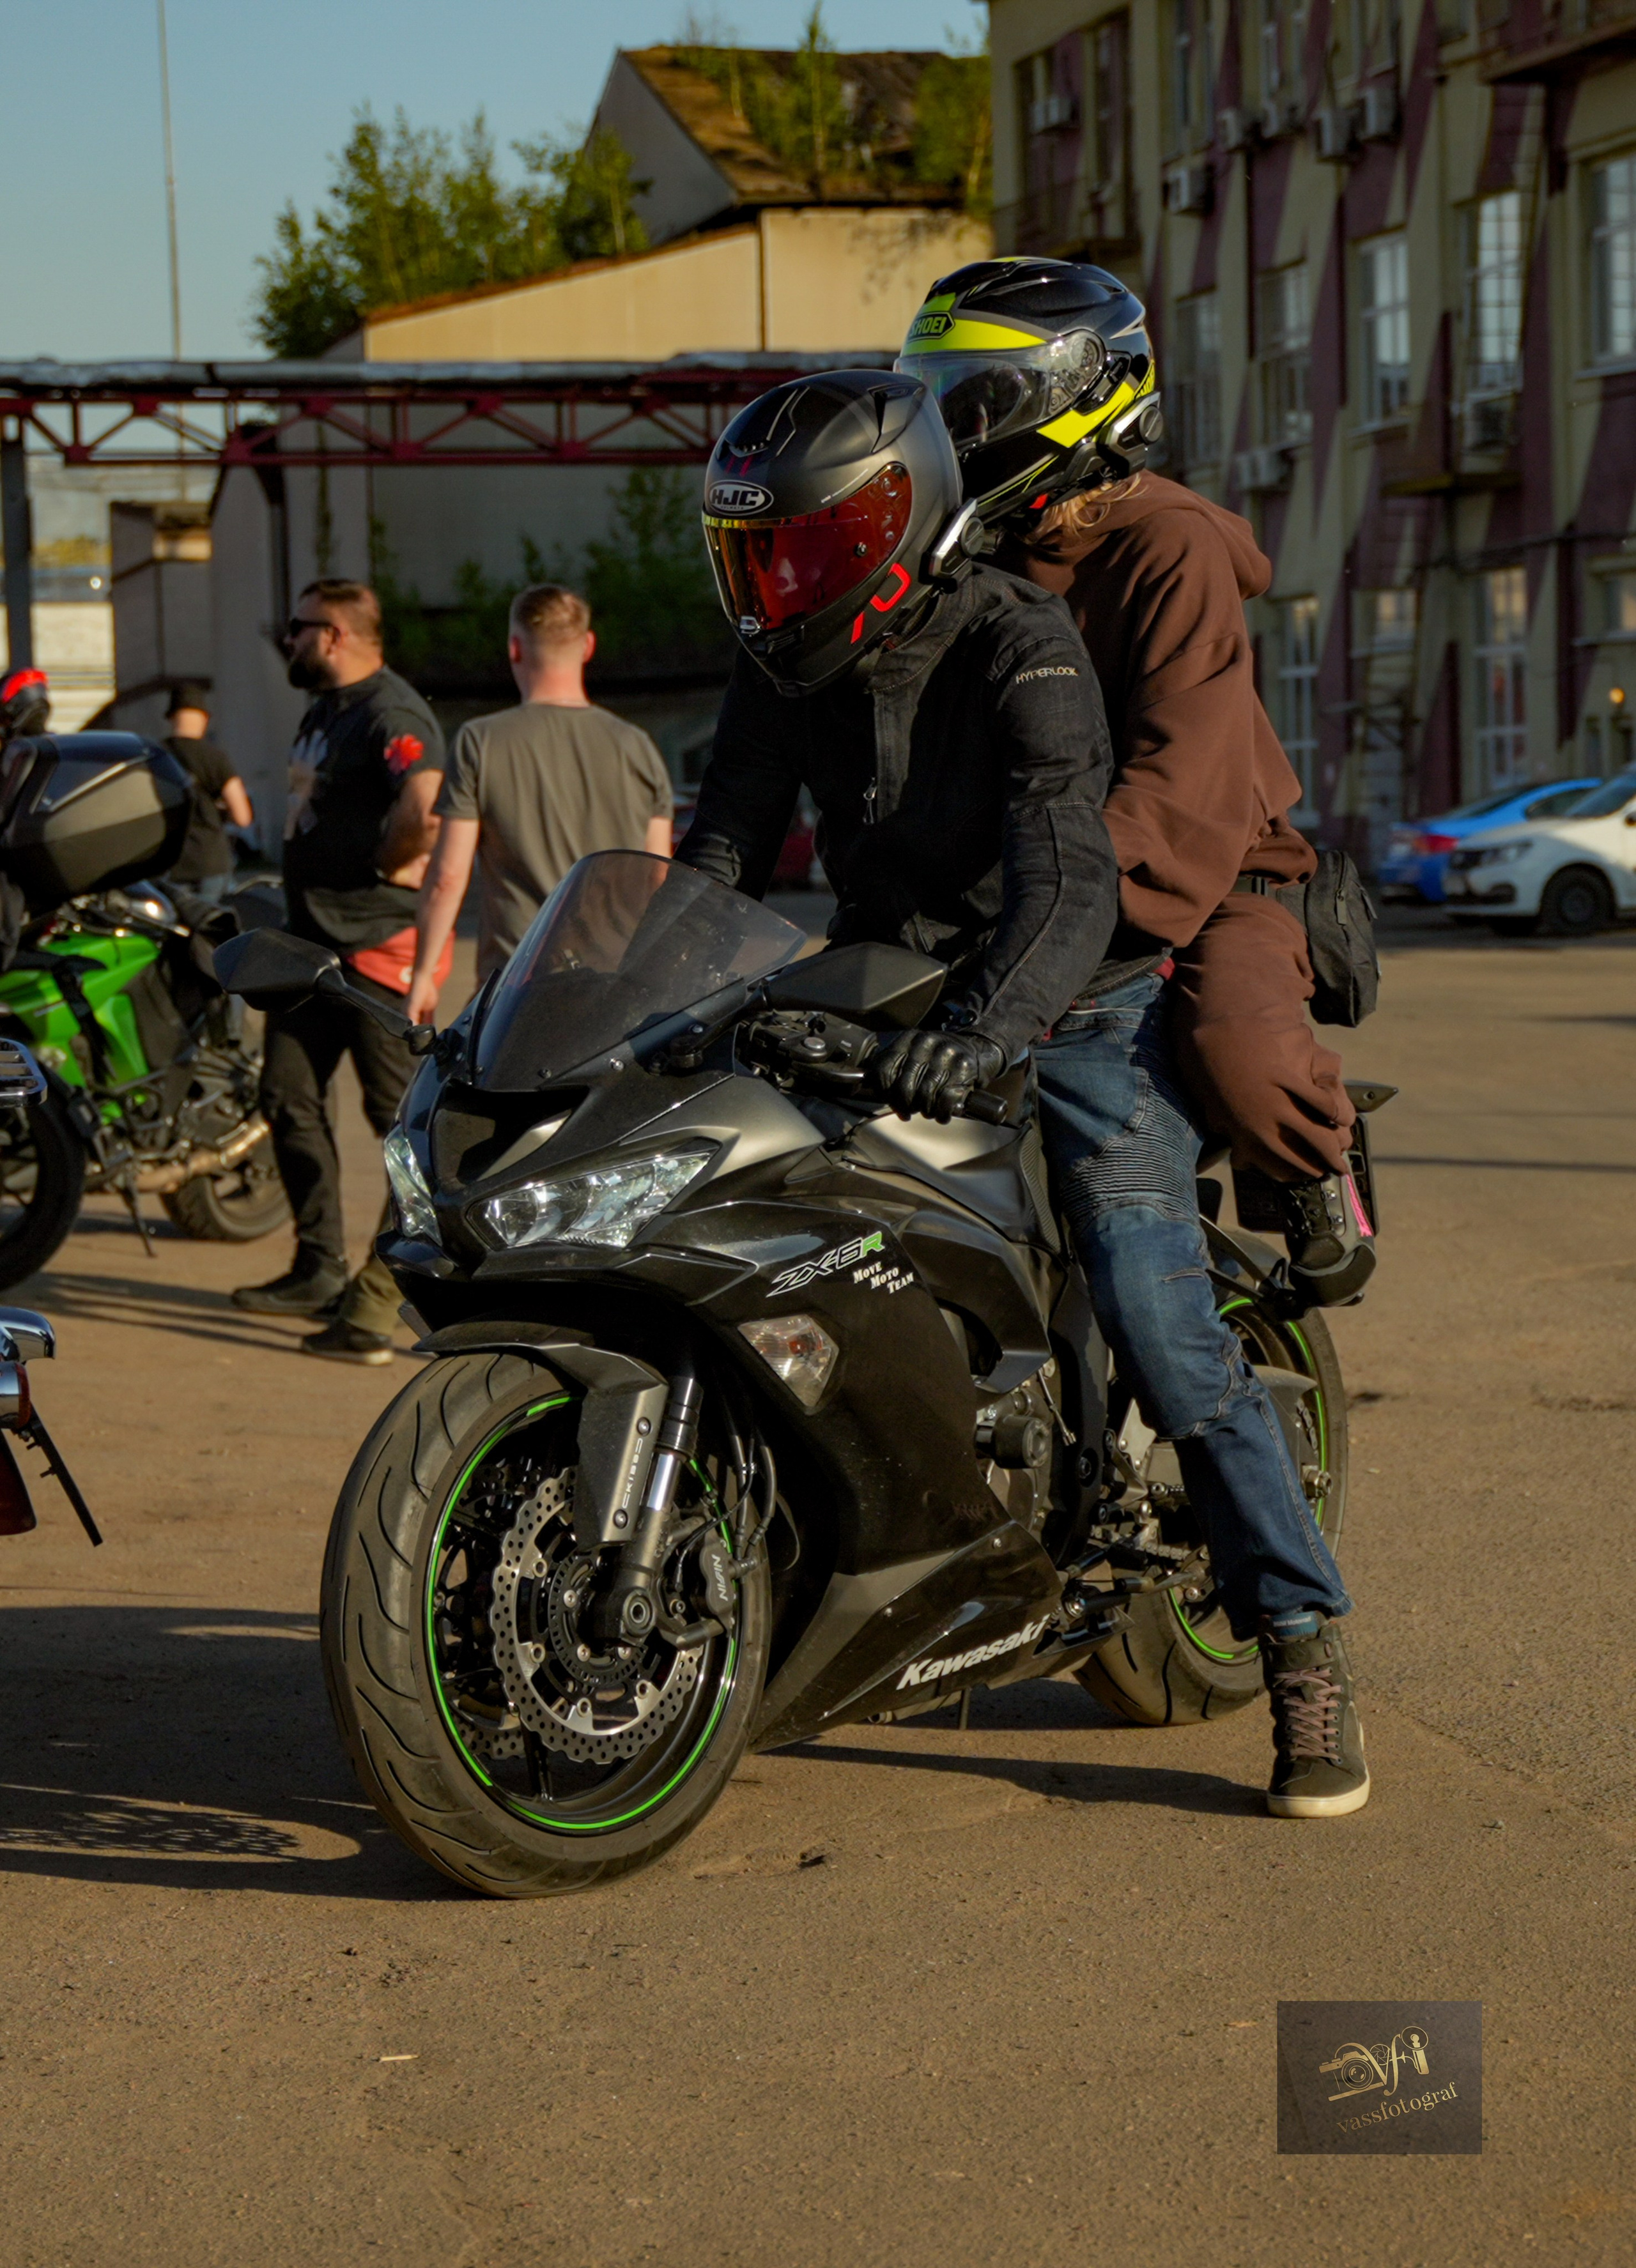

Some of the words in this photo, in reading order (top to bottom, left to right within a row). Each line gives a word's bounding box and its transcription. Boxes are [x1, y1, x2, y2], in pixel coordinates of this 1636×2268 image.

[909, 316, 947, 337] SHOEI
[711, 489, 760, 506] HJC
[1015, 666, 1079, 684] HYPERLOOK
[711, 1554, 729, 1602] NISSIN
[895, 1613, 1051, 1691] Kawasaki
